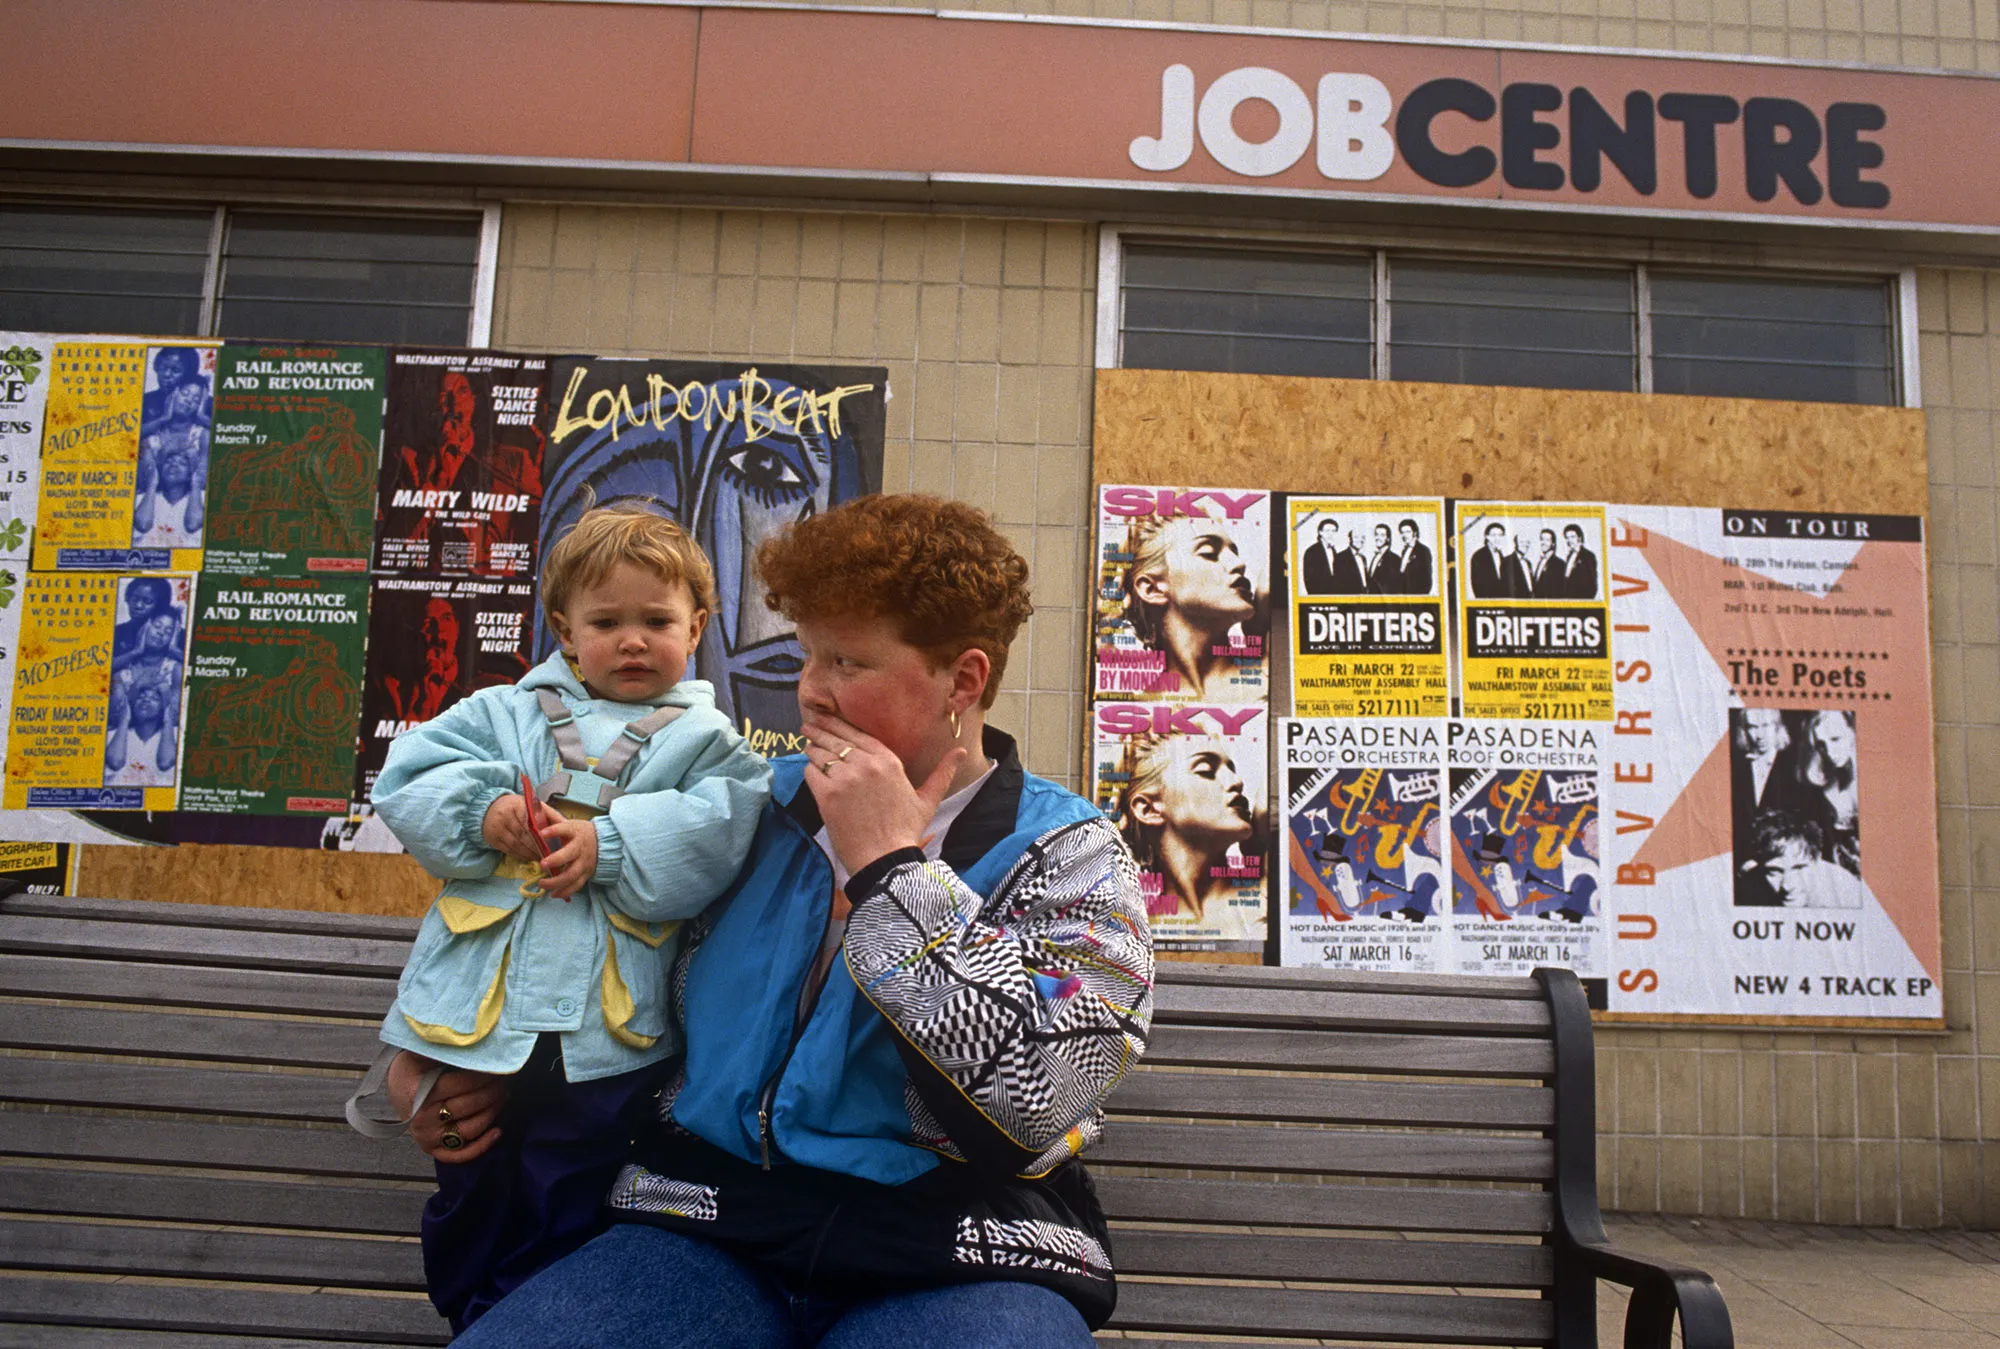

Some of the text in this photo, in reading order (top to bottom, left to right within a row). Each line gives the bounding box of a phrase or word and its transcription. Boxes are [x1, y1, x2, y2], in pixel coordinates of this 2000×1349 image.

[60, 363, 139, 372] THEATRE
[395, 355, 546, 370] WALTHAMSTOW ASSEMBLY HALL
[222, 377, 375, 391] AND REVOLUTION
[67, 387, 125, 396] TROOP
[491, 385, 539, 399] SIXTIES
[493, 400, 537, 412] DANCE
[497, 413, 536, 425] NIGHT
[48, 408, 139, 455] MOTHERS
[215, 423, 256, 434] Sunday
[215, 435, 268, 444] March 17
[7, 471, 27, 483] 15
[45, 471, 133, 485] FRIDAY MARCH 15
[392, 489, 530, 512] MARTY WILDE
[1104, 487, 1267, 520] SKY
[452, 511, 471, 519] WILD
[473, 511, 491, 520] CATS
[1727, 517, 1870, 538] ON TOUR
[382, 543, 430, 553] SALES OFFICE
[490, 543, 528, 551] SATURDAY
[1746, 558, 1766, 567] 28th
[1769, 558, 1783, 568] The
[378, 580, 531, 595] WALTHAMSTOW ASSEMBLY HALL
[1752, 581, 1765, 590] 1st
[29, 594, 109, 603] THEATRE
[203, 607, 358, 624] AND REVOLUTION
[1724, 603, 1741, 612] 2nd
[1776, 605, 1790, 614] 3rd
[1793, 605, 1809, 614] The
[1812, 606, 1831, 615] New
[37, 620, 95, 628] TROOP
[474, 612, 523, 625] SIXTIES
[477, 626, 521, 639] DANCE
[1308, 612, 1435, 643] DRIFTERS
[1475, 616, 1601, 647] DRIFTERS
[481, 640, 520, 652] NIGHT
[17, 641, 110, 689] MOTHERS
[195, 655, 236, 666] Sunday
[1100, 649, 1166, 670] MADONNA
[195, 667, 248, 677] March 17
[1329, 664, 1347, 676] FRI
[1354, 664, 1394, 676] MARCH
[1401, 664, 1414, 676] 22
[1496, 667, 1513, 679] FRI
[1520, 667, 1560, 679] MARCH
[1566, 668, 1580, 680] 22
[1728, 660, 1867, 688] The Poets
[1099, 671, 1180, 692] BY MONDINO
[1300, 678, 1447, 688] WALTHAMSTOW ASSEMBLY HALL
[1468, 681, 1613, 692] WALTHAMSTOW ASSEMBLY HALL
[15, 707, 104, 722] FRIDAY MARCH 15
[1098, 704, 1263, 736] SKY
[1287, 722, 1440, 747] PASADENA
[1447, 722, 1598, 748] PASADENA
[1288, 748, 1440, 764] ROOF ORCHESTRA
[1448, 748, 1598, 765] ROOF ORCHESTRA
[1611, 525, 1658, 993] SUBVERSIVE
[27, 884, 60, 895] ONLY!
[1473, 924, 1506, 932] DANCE
[1733, 920, 1856, 941] OUT NOW
[1323, 946, 1412, 961] SAT MARCH 16
[1483, 945, 1570, 960] SAT MARCH 16
[1734, 975, 1933, 996] NEW 4 TRACK EP
